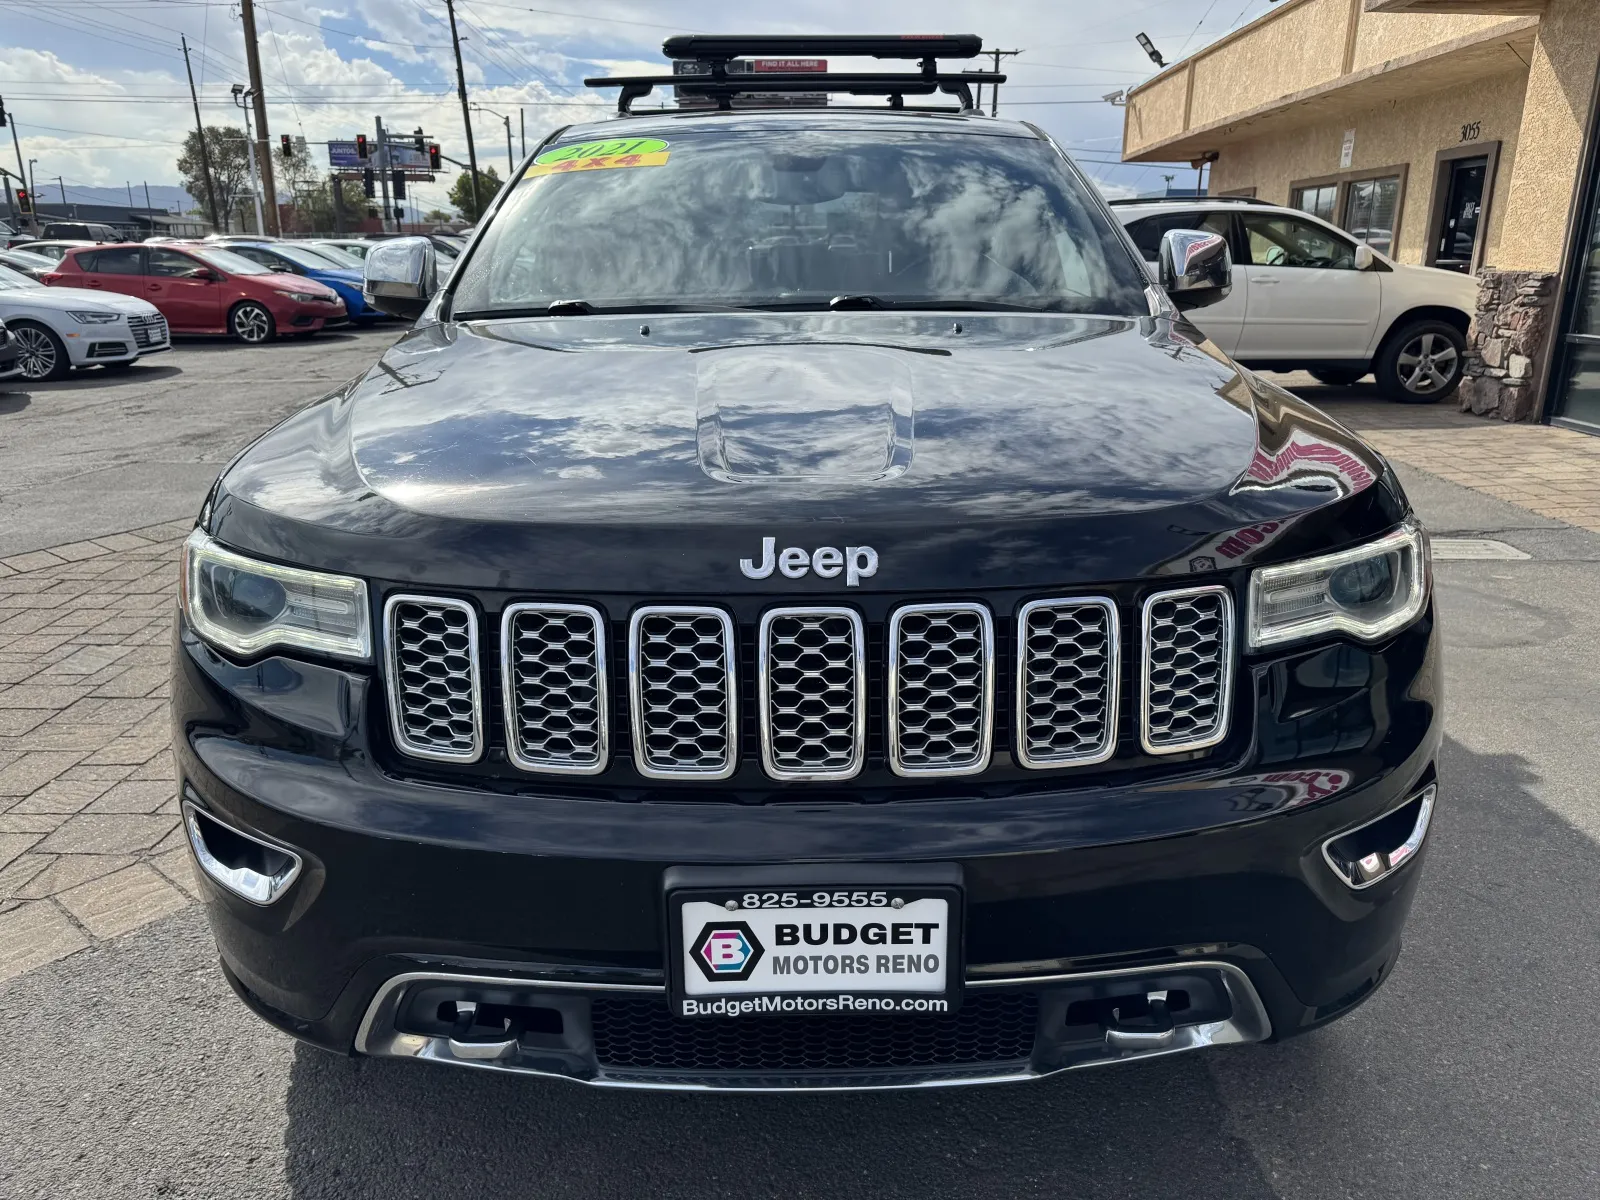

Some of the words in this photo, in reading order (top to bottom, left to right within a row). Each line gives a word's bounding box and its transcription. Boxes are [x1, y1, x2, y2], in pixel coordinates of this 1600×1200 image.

[1459, 121, 1481, 142] 3055
[554, 140, 647, 161] 2021
[739, 536, 879, 587] Jeep
[741, 891, 889, 909] 825-9555
[774, 922, 940, 946] BUDGET
[710, 938, 745, 966] B
[772, 954, 870, 975] MOTORS
[875, 953, 940, 974] RENO
[682, 995, 948, 1017] BudgetMotorsReno.com
